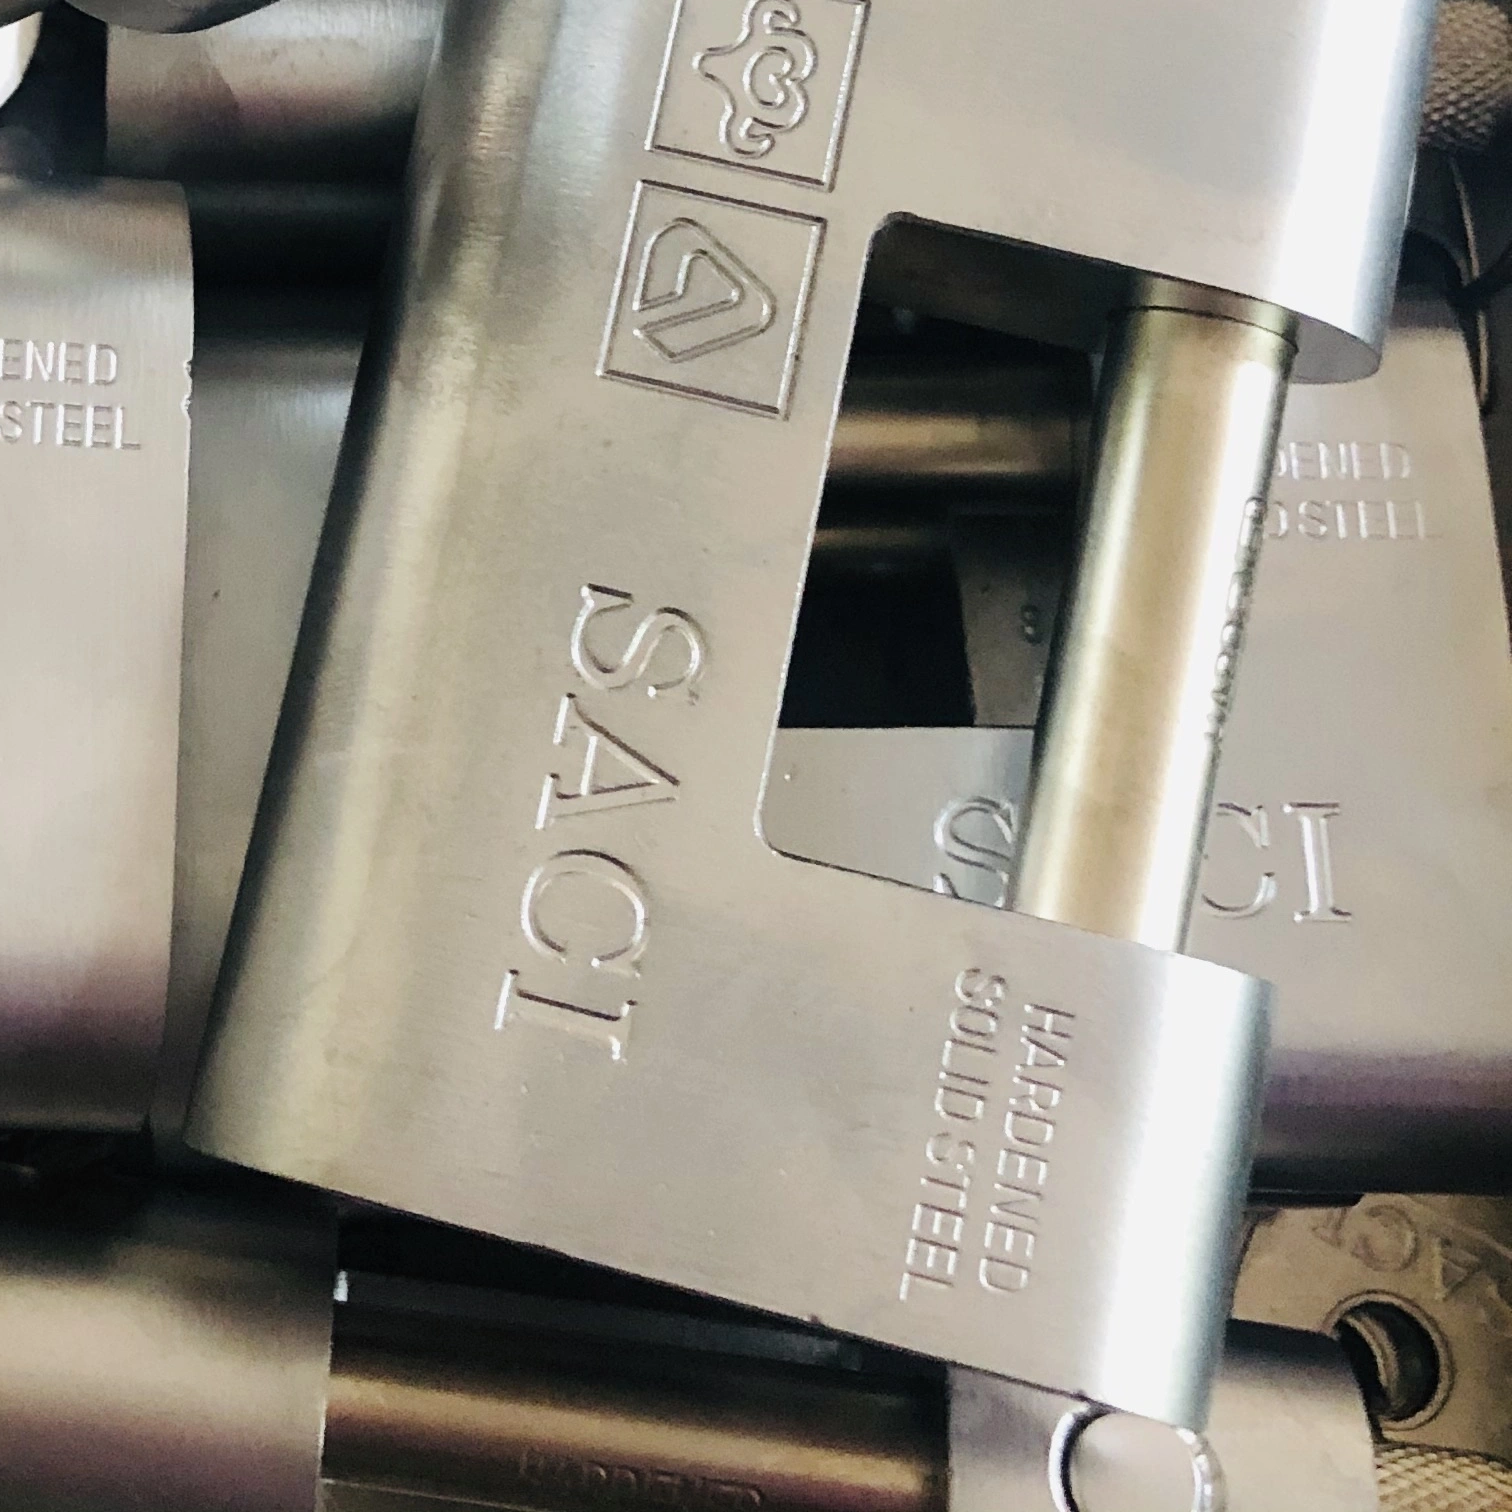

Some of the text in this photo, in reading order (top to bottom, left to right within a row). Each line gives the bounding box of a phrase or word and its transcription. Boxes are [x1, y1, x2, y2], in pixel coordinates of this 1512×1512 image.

[493, 582, 710, 1066] SACI
[934, 795, 1354, 923] SCI
[898, 966, 1008, 1302] SOLID STEEL
[978, 1002, 1077, 1294] HARDENED
